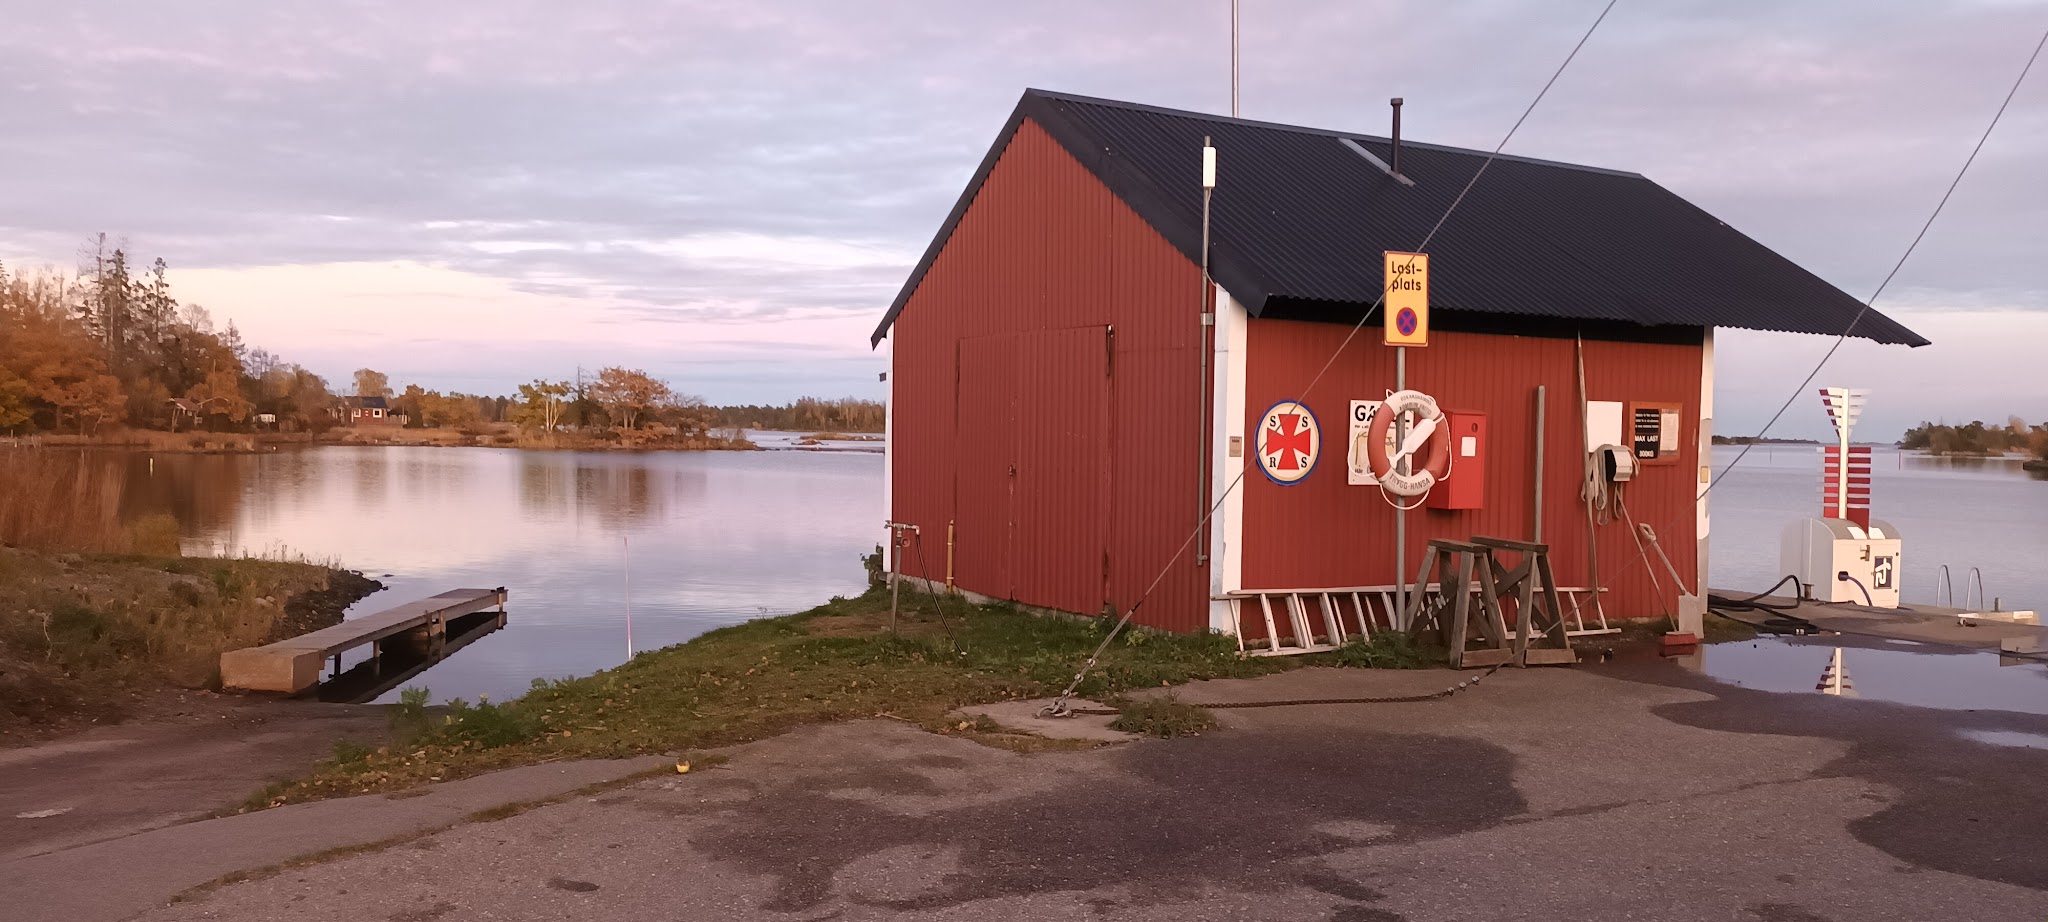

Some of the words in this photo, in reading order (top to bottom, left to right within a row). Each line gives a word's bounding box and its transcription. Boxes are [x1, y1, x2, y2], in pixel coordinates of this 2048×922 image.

[1391, 260, 1422, 275] Last-
[1392, 277, 1422, 293] plats
[1269, 415, 1277, 428] S
[1301, 415, 1309, 428] S
[1269, 456, 1277, 468] R
[1300, 456, 1308, 468] S
[1389, 473, 1431, 490] TRYGG-HANSA
